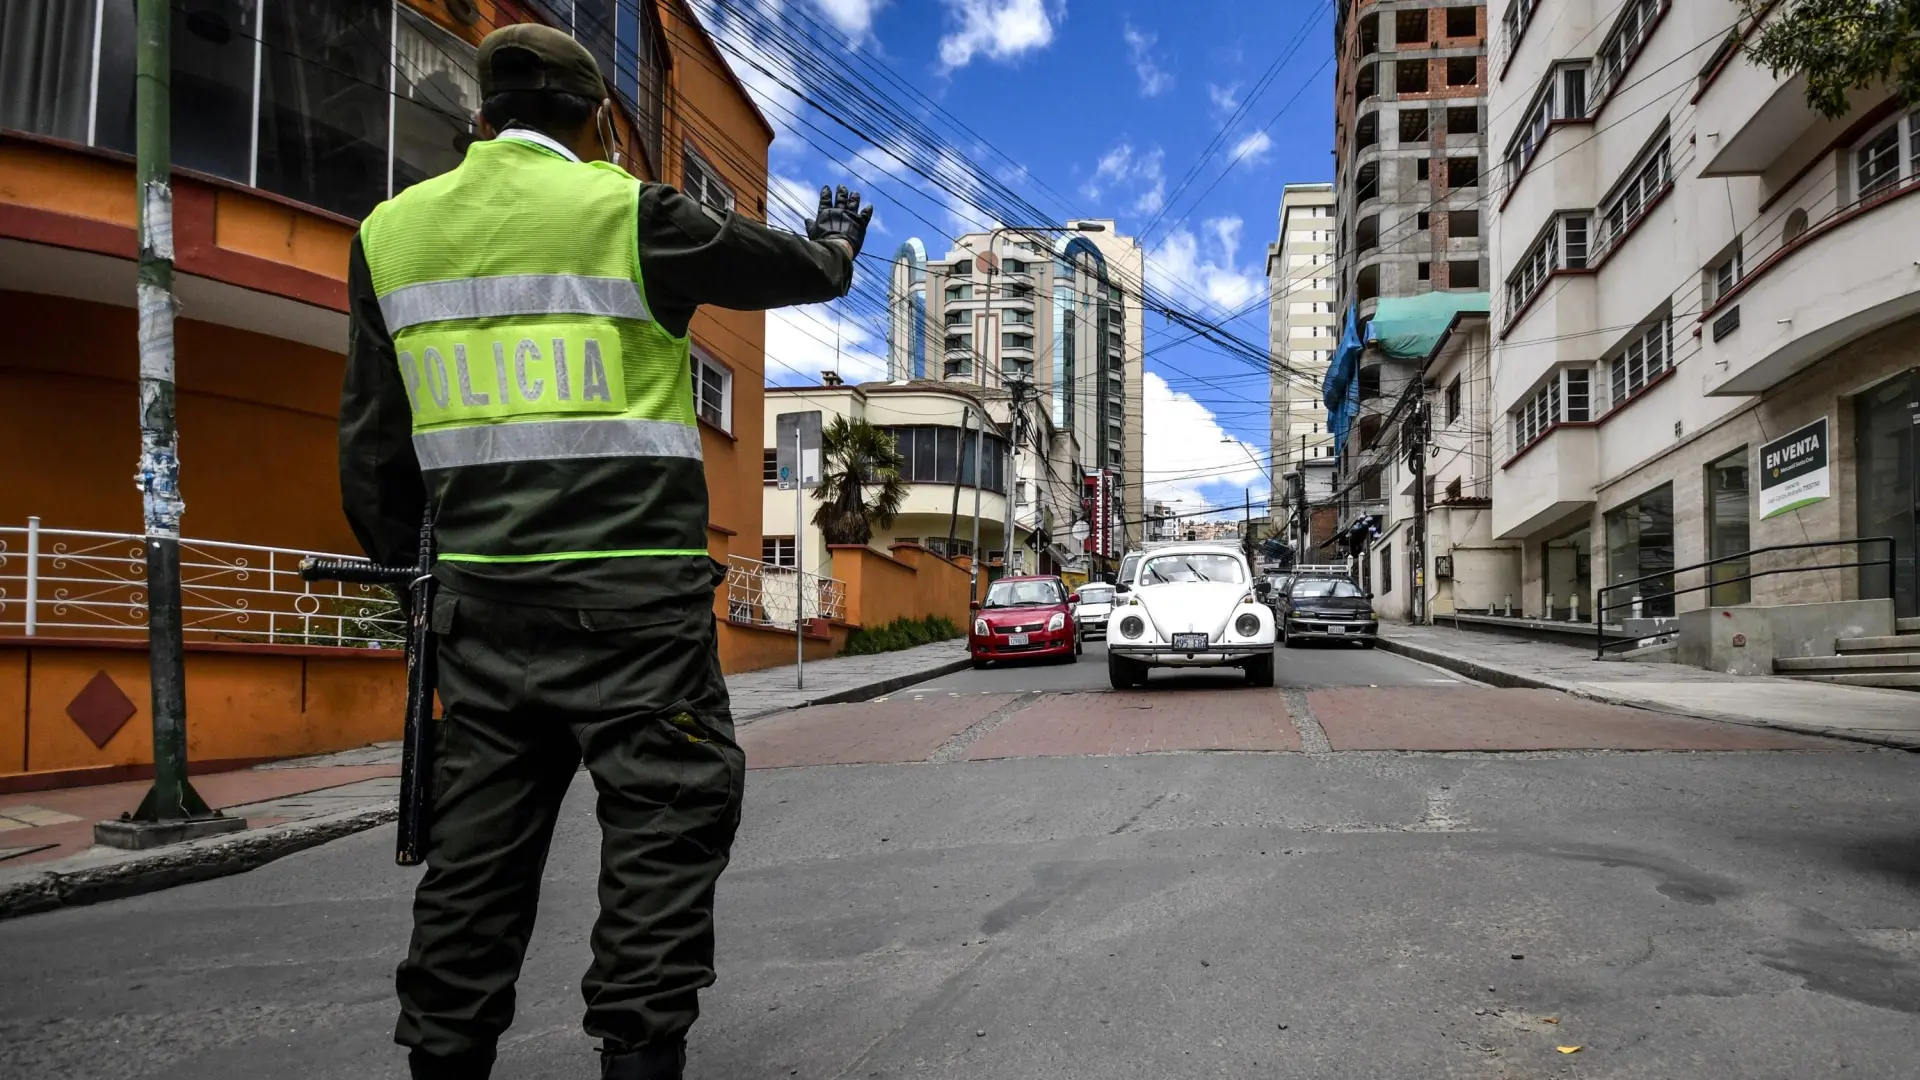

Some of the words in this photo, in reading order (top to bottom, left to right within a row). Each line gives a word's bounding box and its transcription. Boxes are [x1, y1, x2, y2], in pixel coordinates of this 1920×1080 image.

[399, 338, 612, 413] POLICIA
[1766, 451, 1780, 469] EN
[1782, 434, 1819, 462] VENTA
